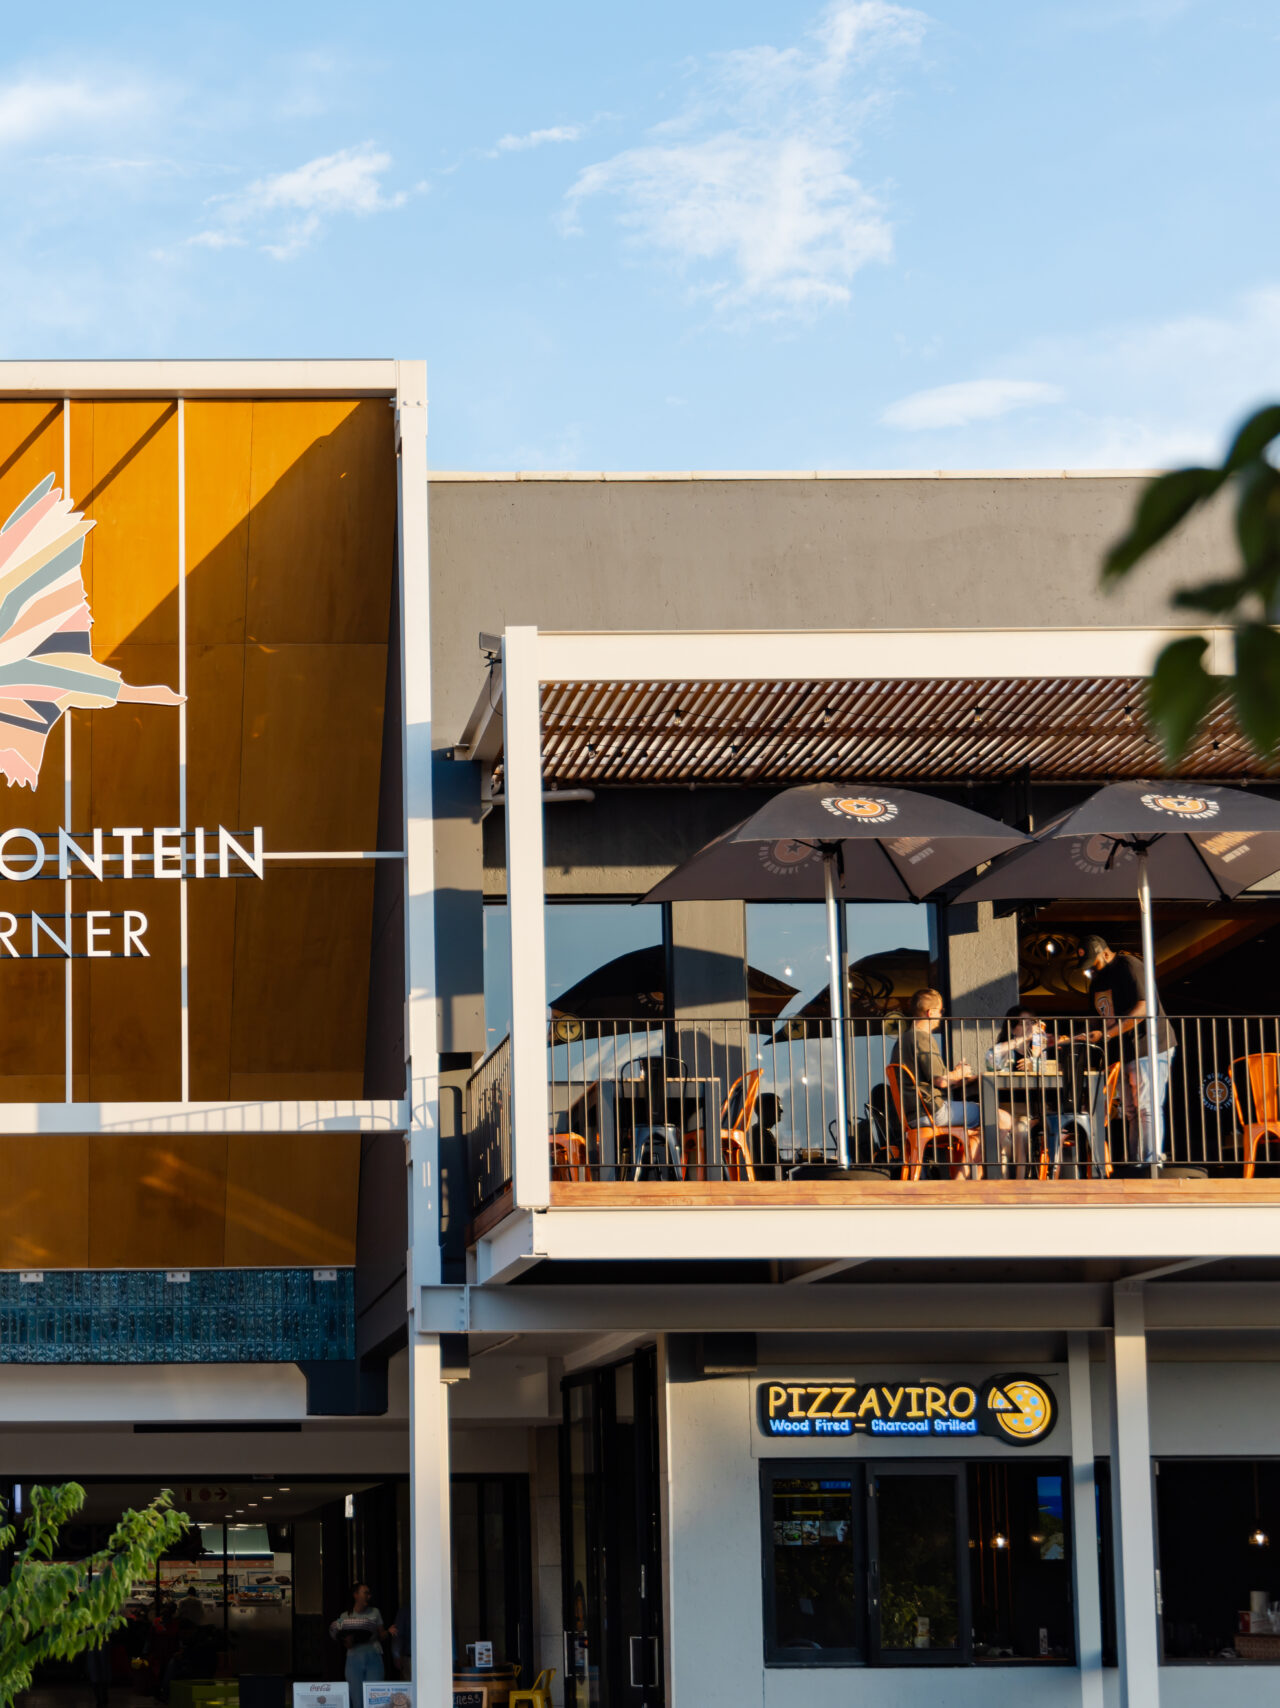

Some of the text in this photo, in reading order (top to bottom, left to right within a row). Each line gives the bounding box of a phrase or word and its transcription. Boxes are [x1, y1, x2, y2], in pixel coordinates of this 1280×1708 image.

[769, 1386, 976, 1418] PIZZAYIRO
[770, 1419, 809, 1431] Wood
[815, 1419, 850, 1431] Fired
[871, 1419, 928, 1431] Charcoal
[934, 1419, 976, 1431] Grilled
